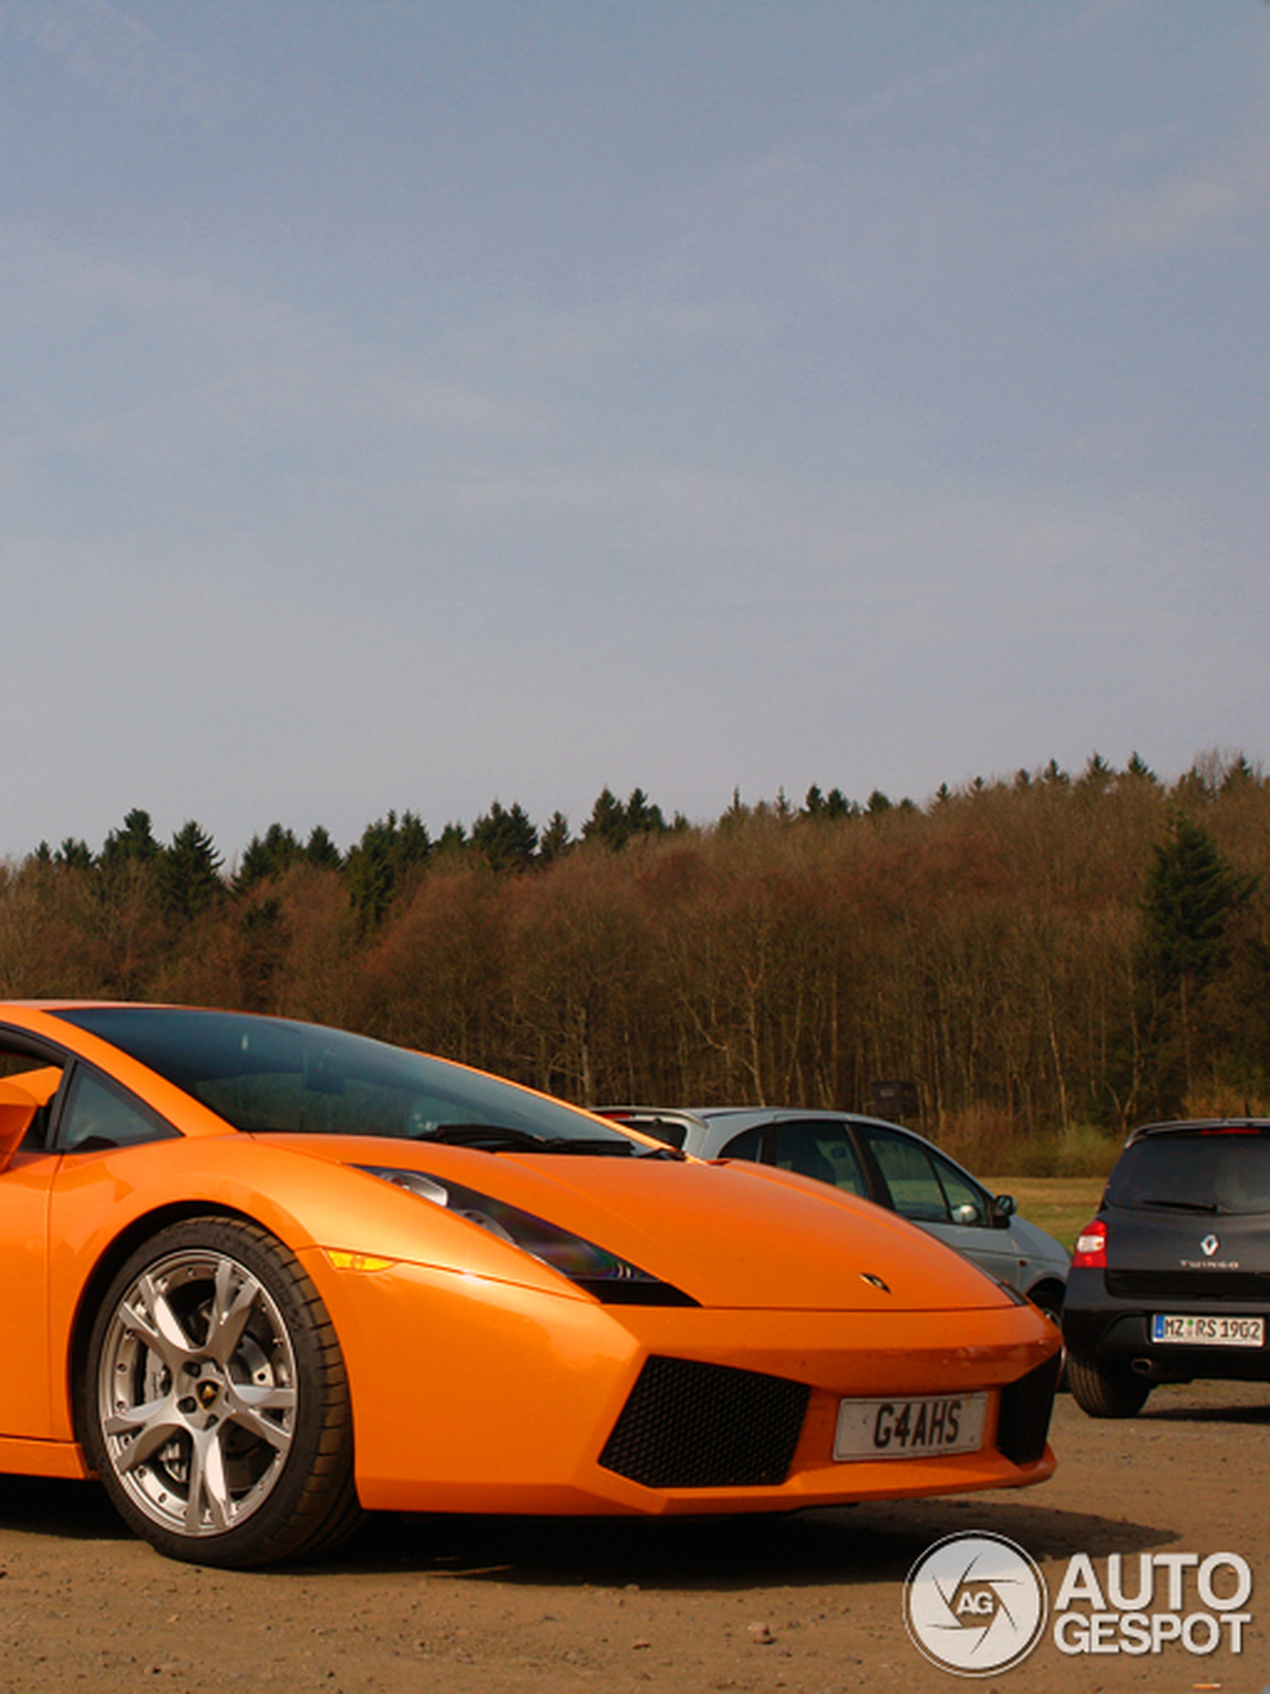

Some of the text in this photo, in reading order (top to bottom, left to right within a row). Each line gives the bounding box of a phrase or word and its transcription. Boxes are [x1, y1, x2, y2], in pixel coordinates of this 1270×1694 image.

[1165, 1319, 1260, 1340] MZ RS 1902
[873, 1401, 962, 1448] G4AHS
